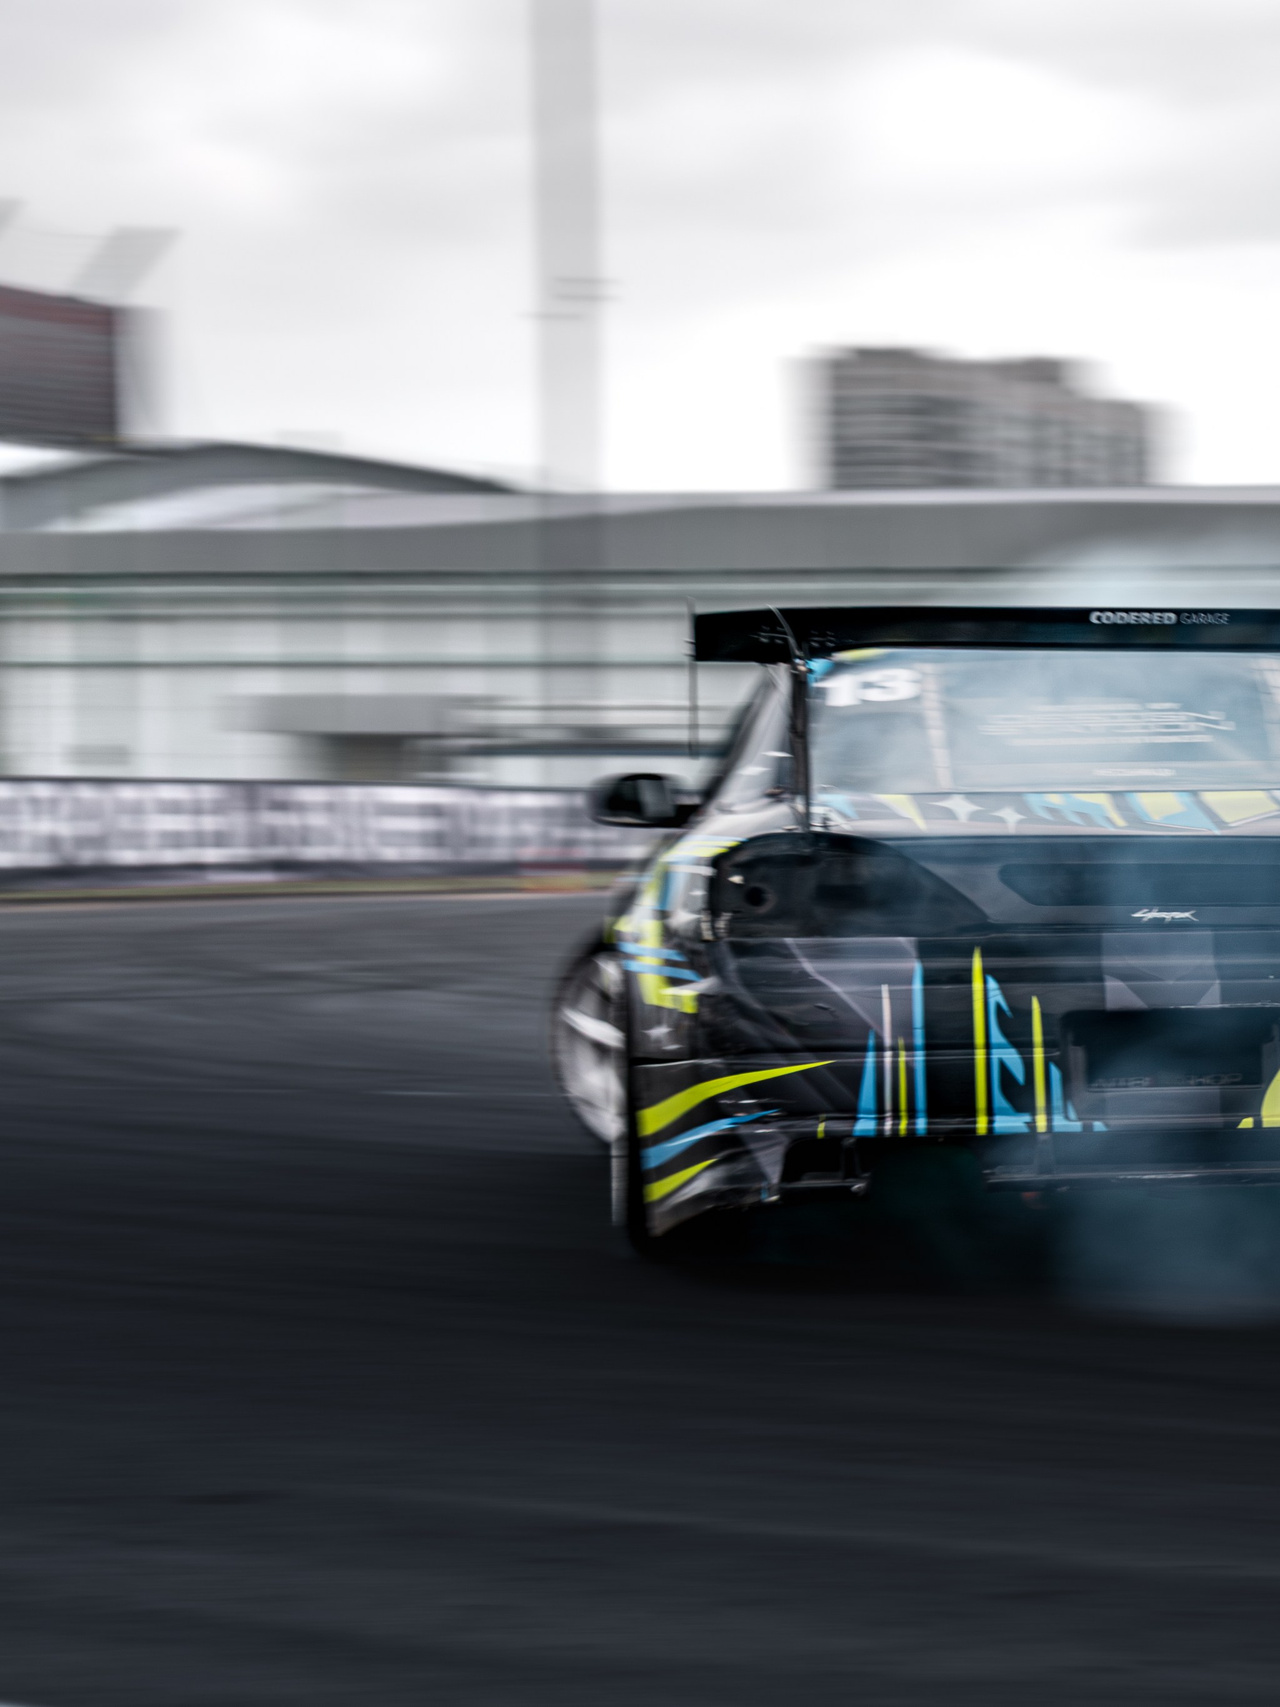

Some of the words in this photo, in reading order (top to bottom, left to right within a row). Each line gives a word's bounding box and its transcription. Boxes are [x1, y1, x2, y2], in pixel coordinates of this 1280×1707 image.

[1089, 611, 1178, 625] CODERED
[1179, 612, 1231, 625] GARAGE
[811, 668, 920, 707] 13
